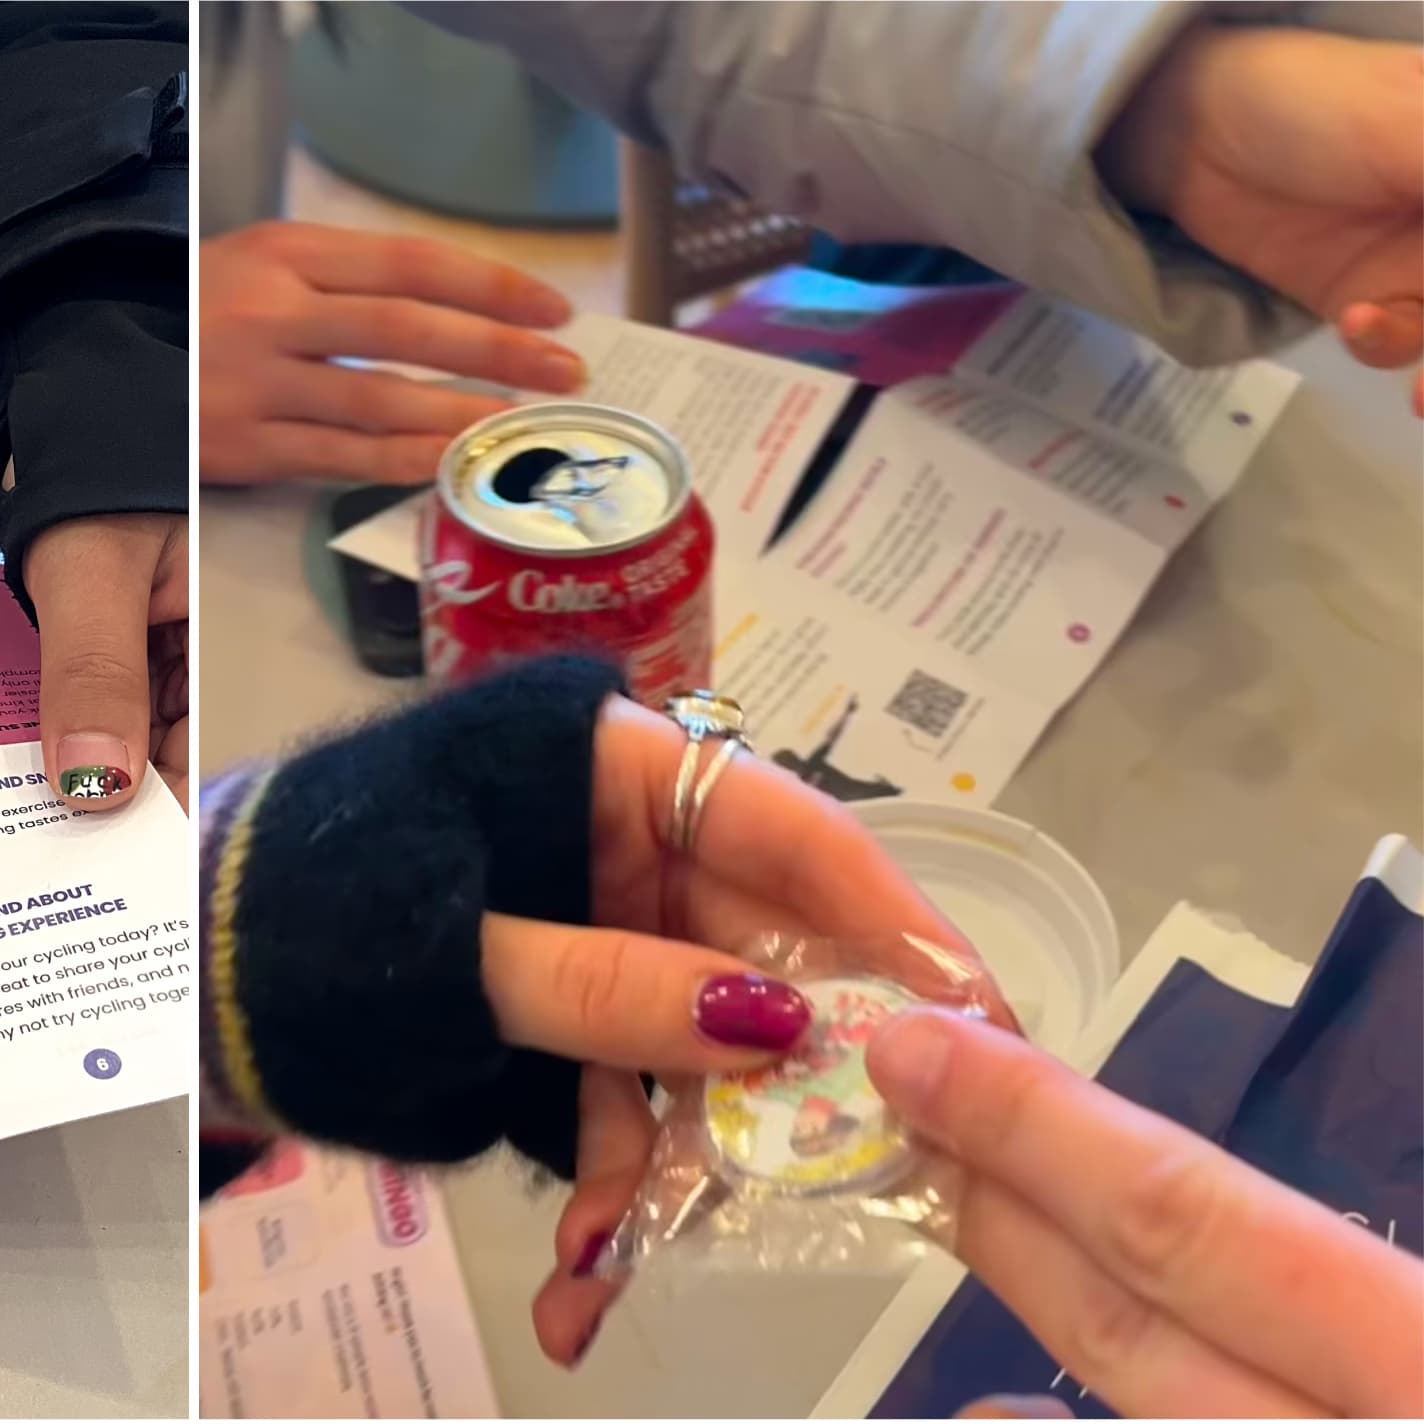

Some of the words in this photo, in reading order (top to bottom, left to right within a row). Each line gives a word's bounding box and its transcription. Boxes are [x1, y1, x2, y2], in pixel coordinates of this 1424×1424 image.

[508, 570, 611, 614] Coke
[68, 773, 121, 794] Fuck
[27, 884, 92, 910] ABOUT
[8, 898, 127, 936] EXPERIENCE
[97, 1059, 108, 1071] 6
